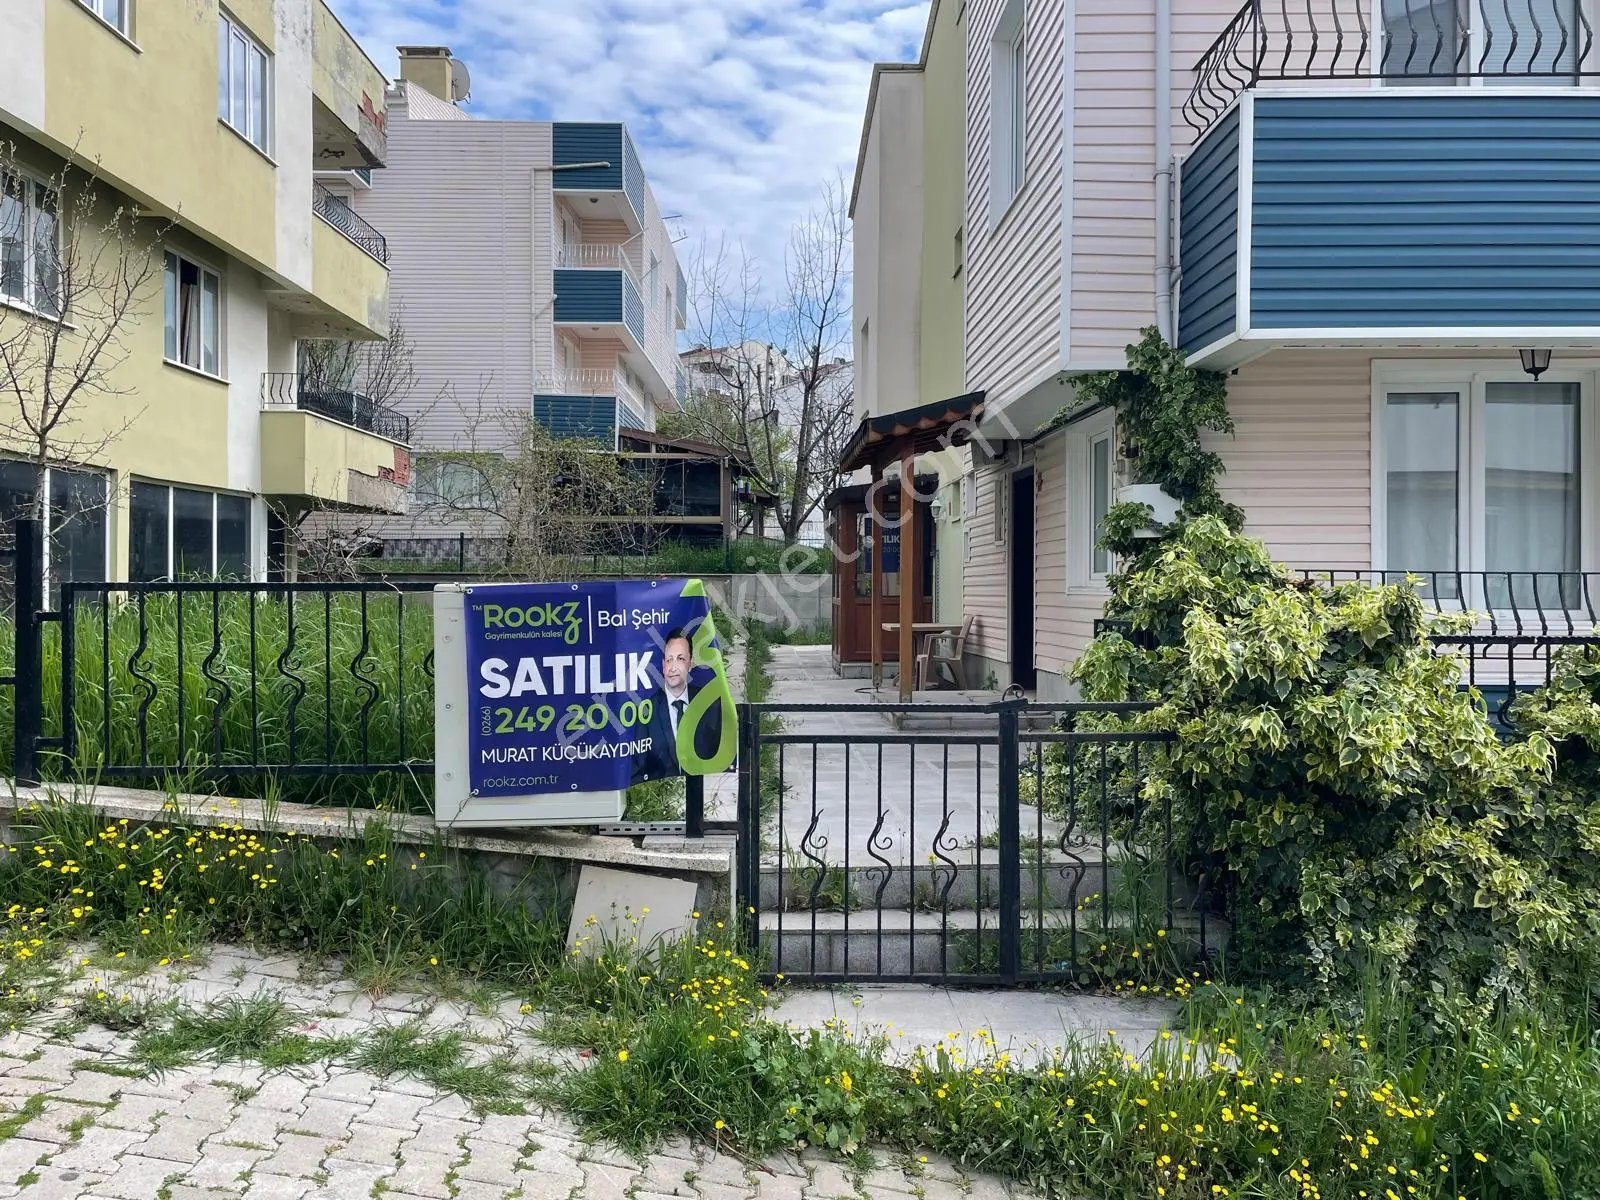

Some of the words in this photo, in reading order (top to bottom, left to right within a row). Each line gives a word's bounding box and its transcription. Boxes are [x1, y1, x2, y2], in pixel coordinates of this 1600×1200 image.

[598, 609, 627, 627] Bal
[631, 608, 671, 630] Şehir
[541, 630, 563, 639] kalesi
[479, 651, 654, 699] SATILIK
[481, 706, 492, 736] (0266)
[495, 705, 556, 734] 249
[566, 703, 609, 731] 20
[619, 699, 653, 727] 00
[481, 747, 537, 763] MURAT
[542, 737, 653, 764] KÜÇÜKAYDINER
[483, 775, 559, 788] rookz.com.tr
